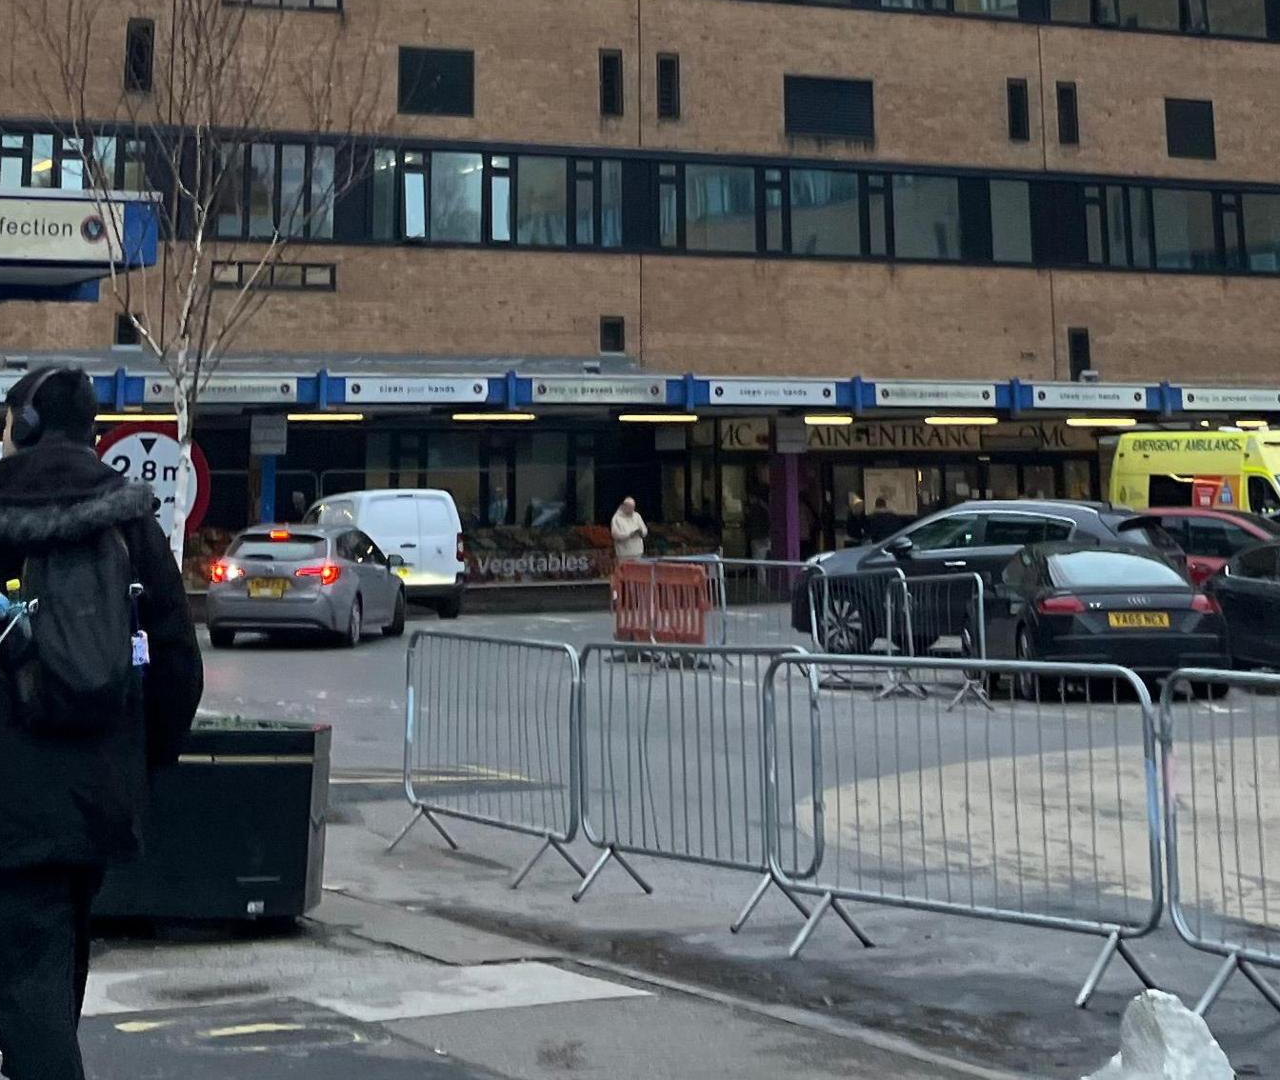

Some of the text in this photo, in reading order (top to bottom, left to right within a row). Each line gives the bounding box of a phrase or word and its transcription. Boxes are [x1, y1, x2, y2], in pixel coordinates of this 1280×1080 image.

[379, 384, 404, 394] clean
[427, 383, 456, 394] hands
[1131, 438, 1180, 452] EMERGENCY
[477, 552, 589, 576] Vegetables
